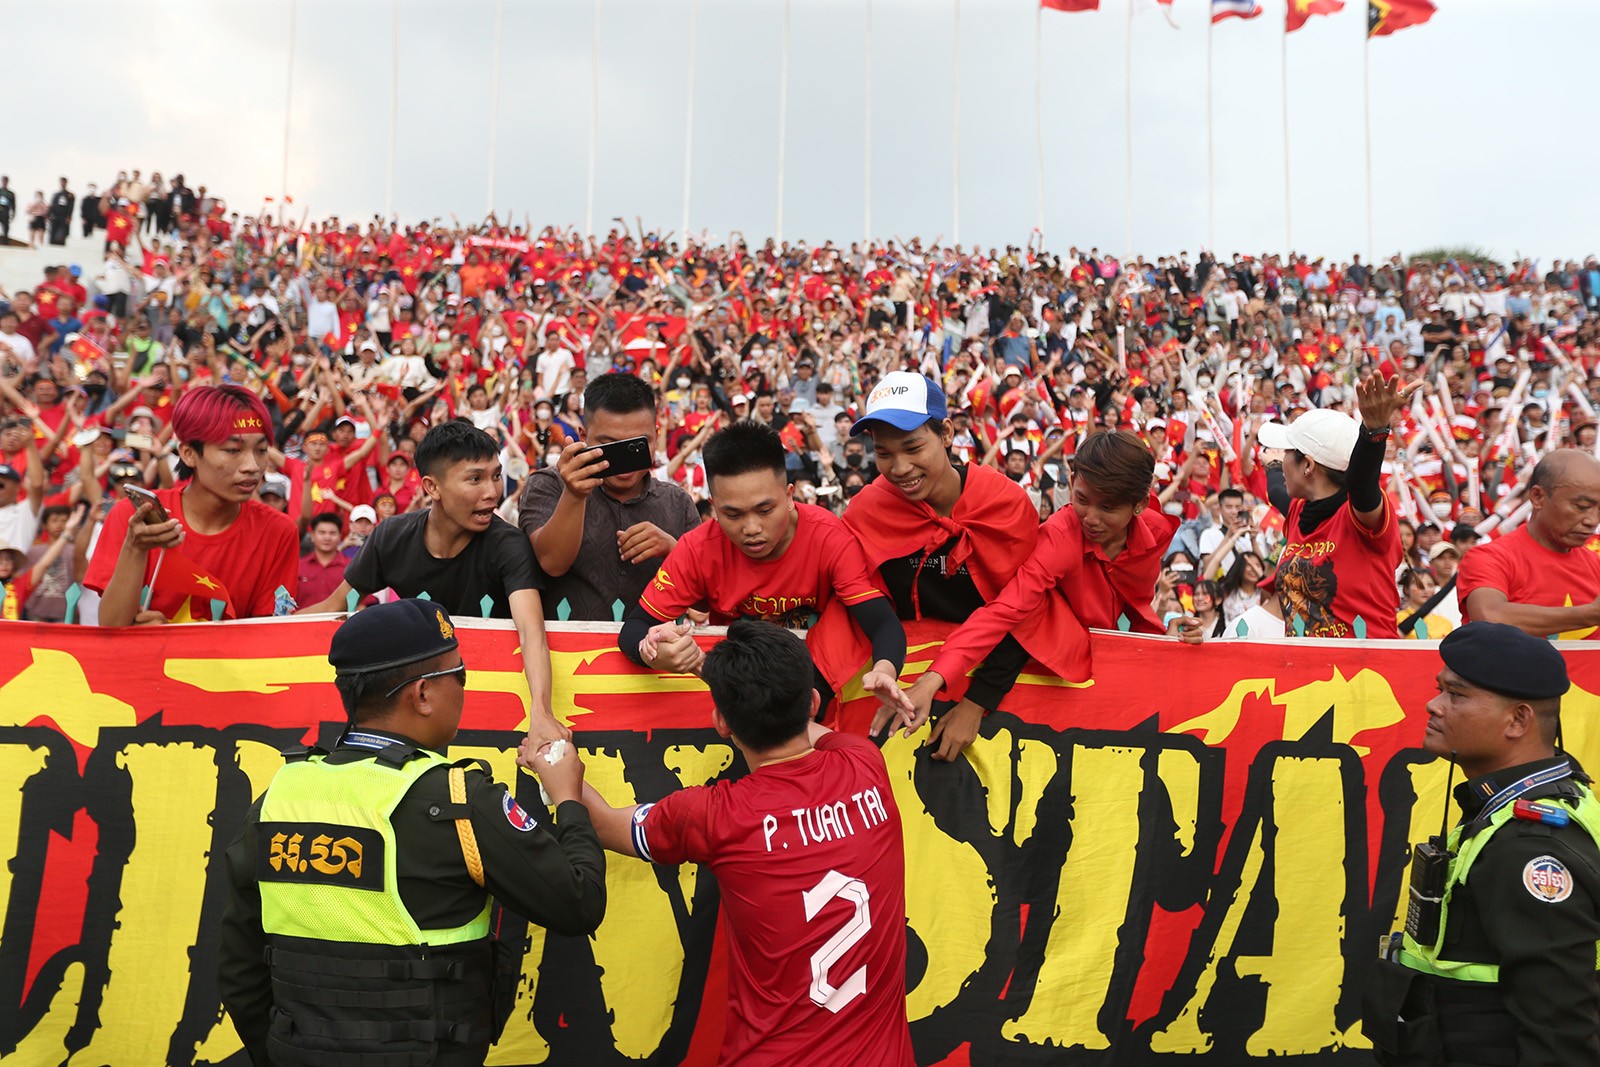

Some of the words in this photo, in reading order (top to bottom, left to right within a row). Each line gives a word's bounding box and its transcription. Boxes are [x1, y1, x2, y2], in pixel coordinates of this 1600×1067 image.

[762, 814, 789, 852] P.
[792, 800, 855, 847] TUAN
[851, 786, 889, 830] TAI
[802, 869, 872, 1014] 2
